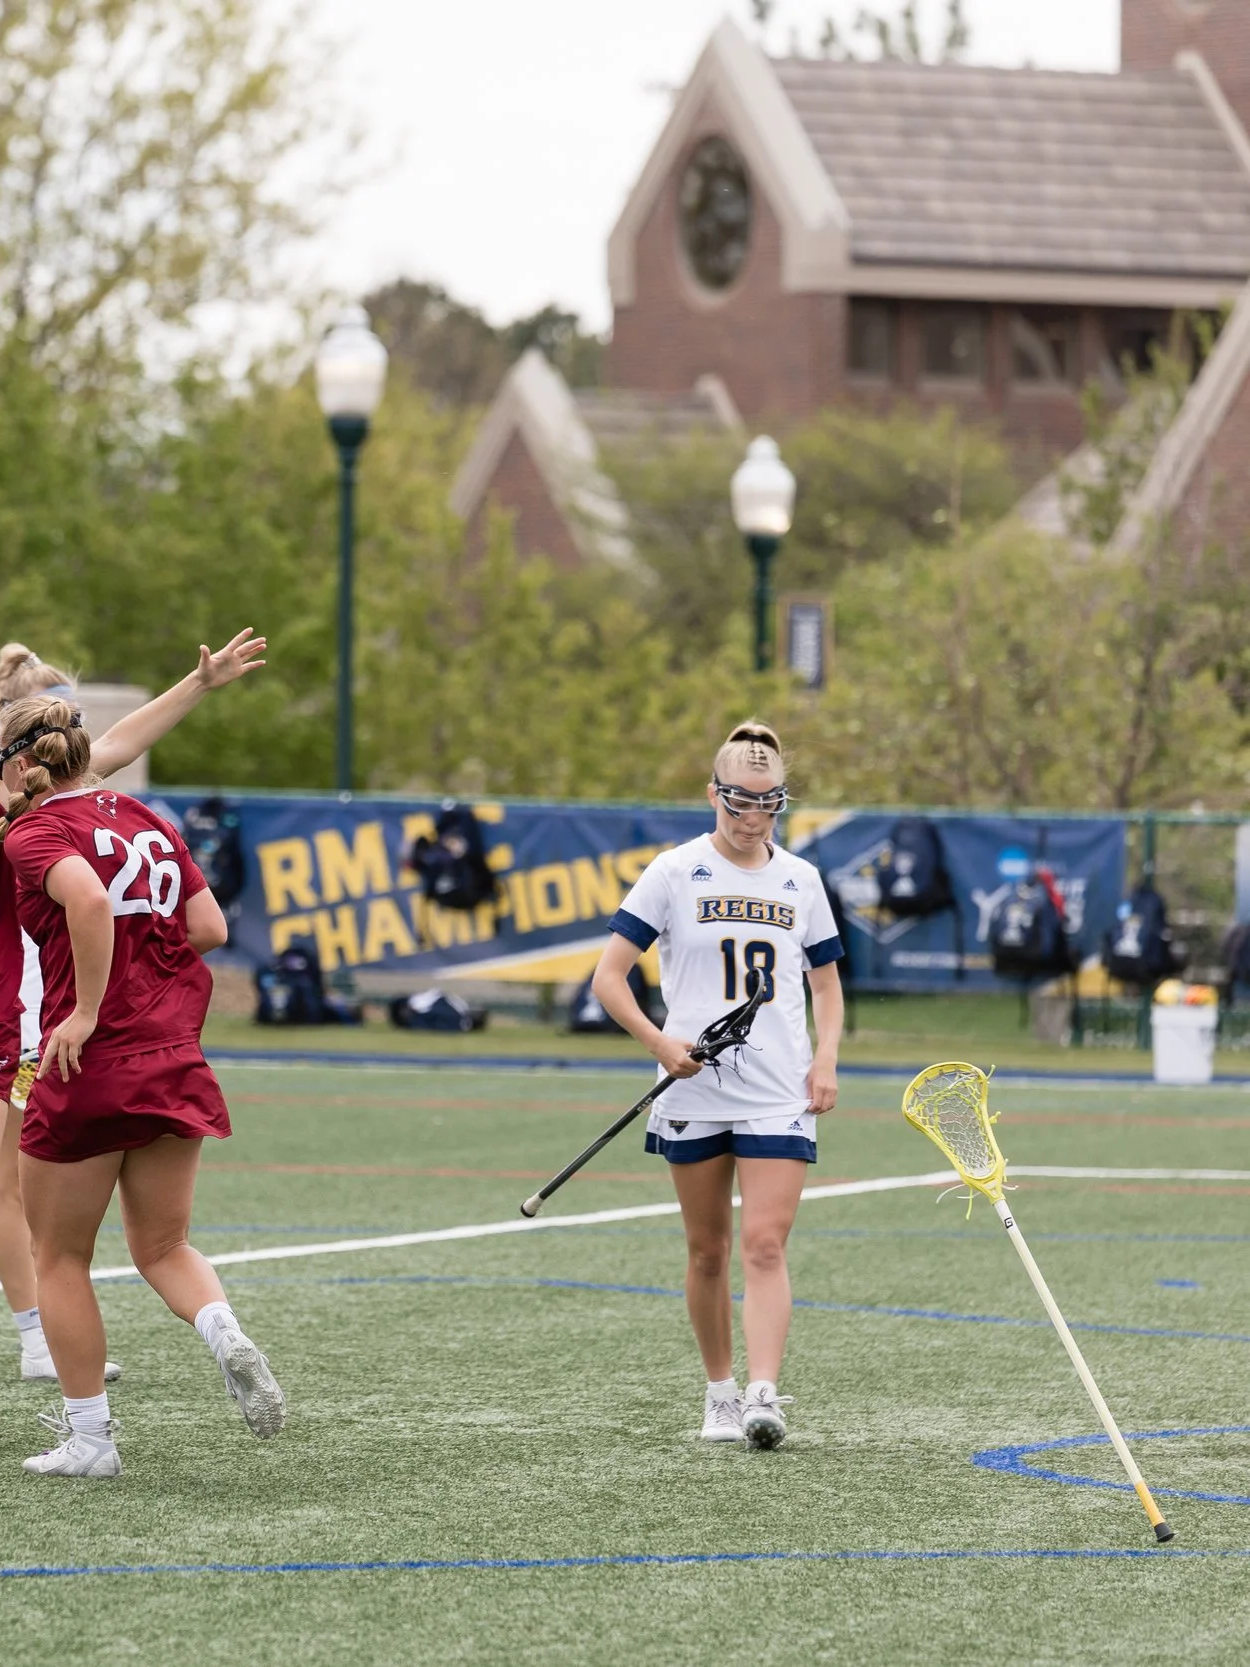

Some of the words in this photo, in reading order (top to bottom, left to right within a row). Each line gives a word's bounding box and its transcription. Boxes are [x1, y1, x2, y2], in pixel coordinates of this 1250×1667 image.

[8, 738, 29, 754] STX
[93, 827, 181, 918] 26
[697, 896, 795, 930] REGIS
[720, 937, 777, 1004] 18
